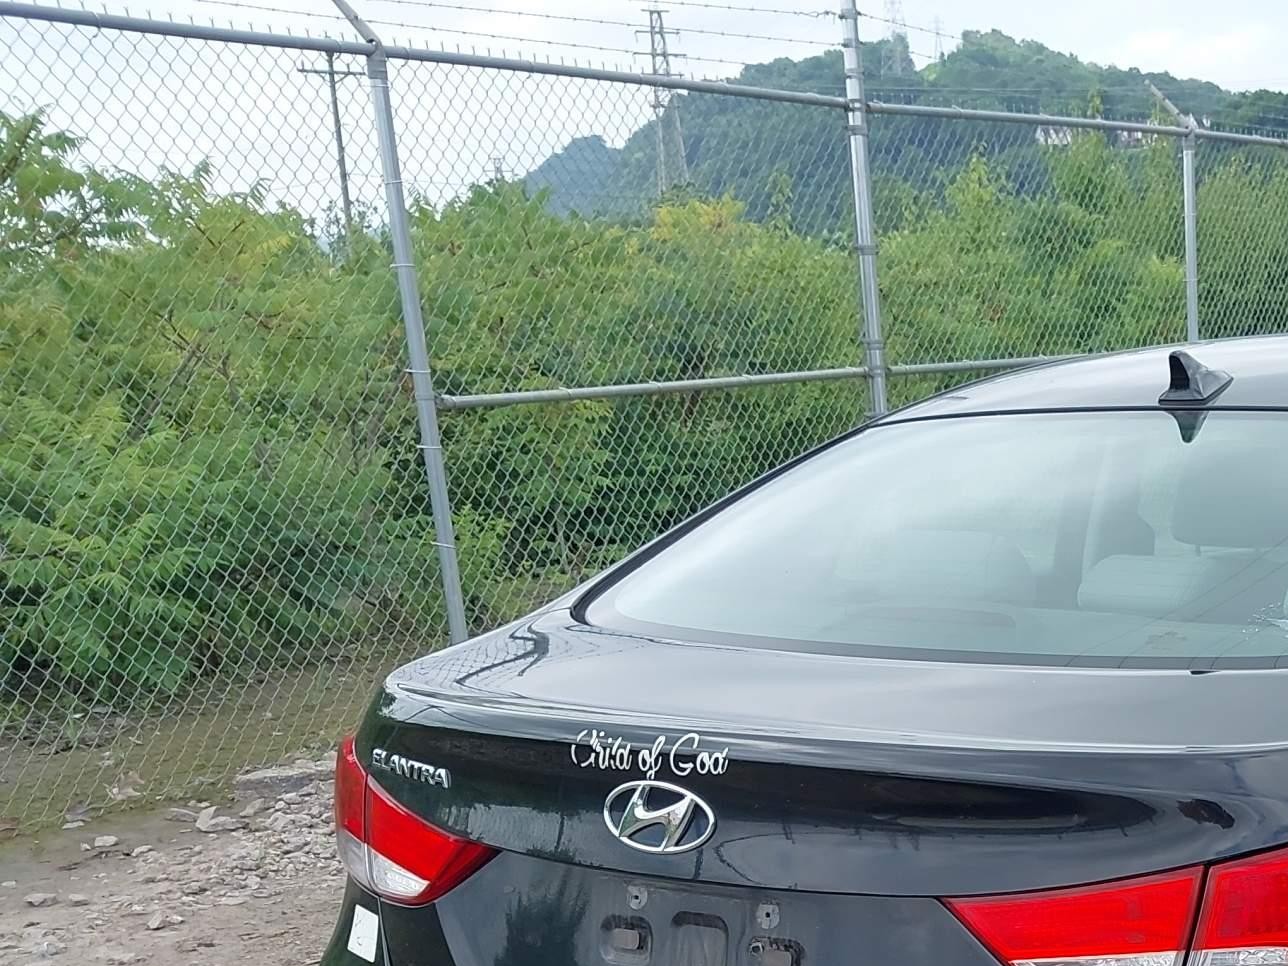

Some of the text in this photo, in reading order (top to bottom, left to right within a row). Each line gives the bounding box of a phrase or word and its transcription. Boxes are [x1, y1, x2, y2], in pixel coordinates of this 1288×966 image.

[371, 748, 452, 789] ELANTRA
[638, 735, 662, 780] of
[669, 732, 729, 776] God
